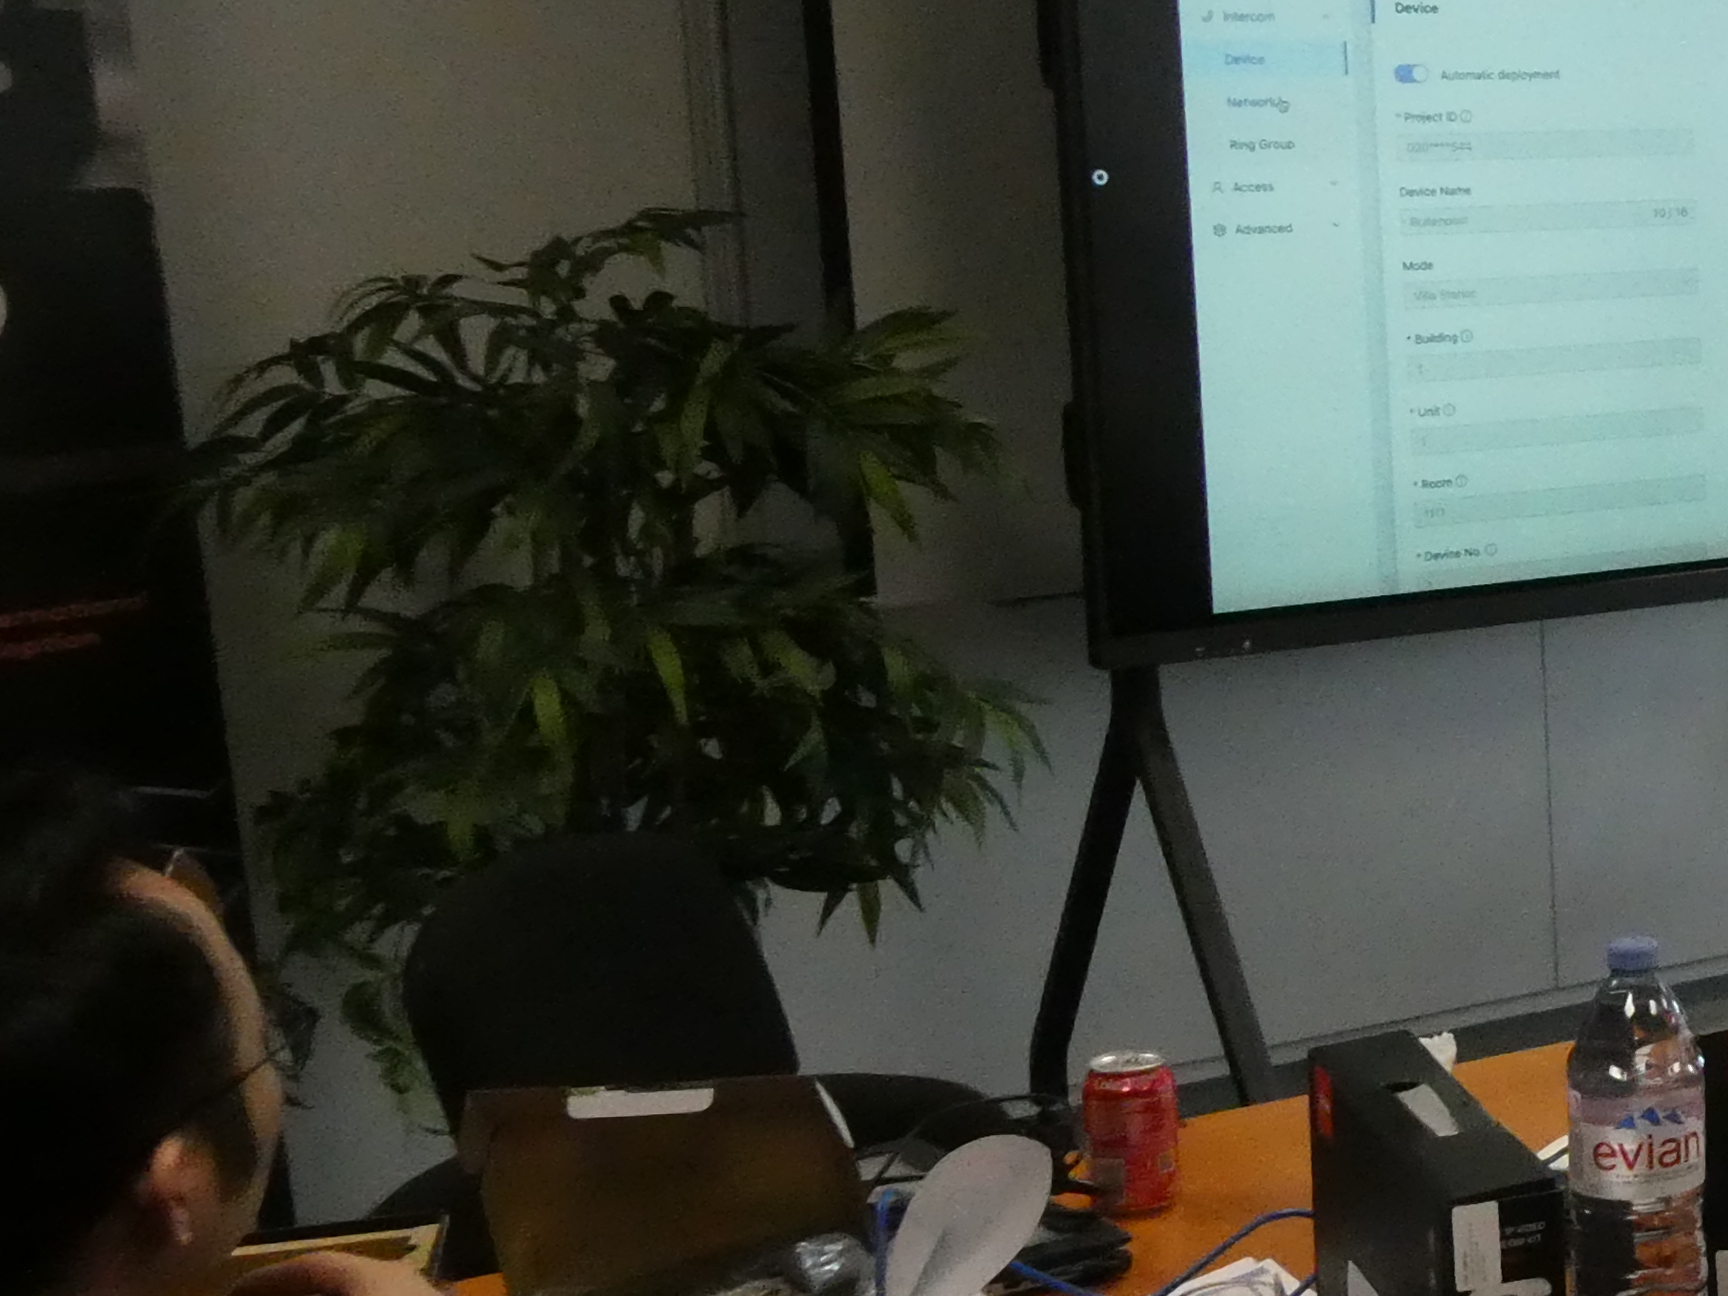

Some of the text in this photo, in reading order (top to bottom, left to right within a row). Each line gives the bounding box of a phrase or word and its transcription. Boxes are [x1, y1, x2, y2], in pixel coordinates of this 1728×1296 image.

[1394, 1, 1439, 15] Device
[1223, 10, 1276, 23] Intercom
[1225, 53, 1266, 66] Device
[1441, 69, 1560, 82] Automatic deployment
[1404, 111, 1442, 124] Project
[1230, 139, 1296, 153] Ring Group
[1233, 181, 1275, 193] Access
[1400, 185, 1471, 197] Device Name
[1235, 222, 1294, 235] Advanced
[1402, 260, 1434, 271] Mode
[1414, 333, 1459, 345] Building
[1418, 406, 1441, 418] Unit
[1593, 1129, 1702, 1172] evian
